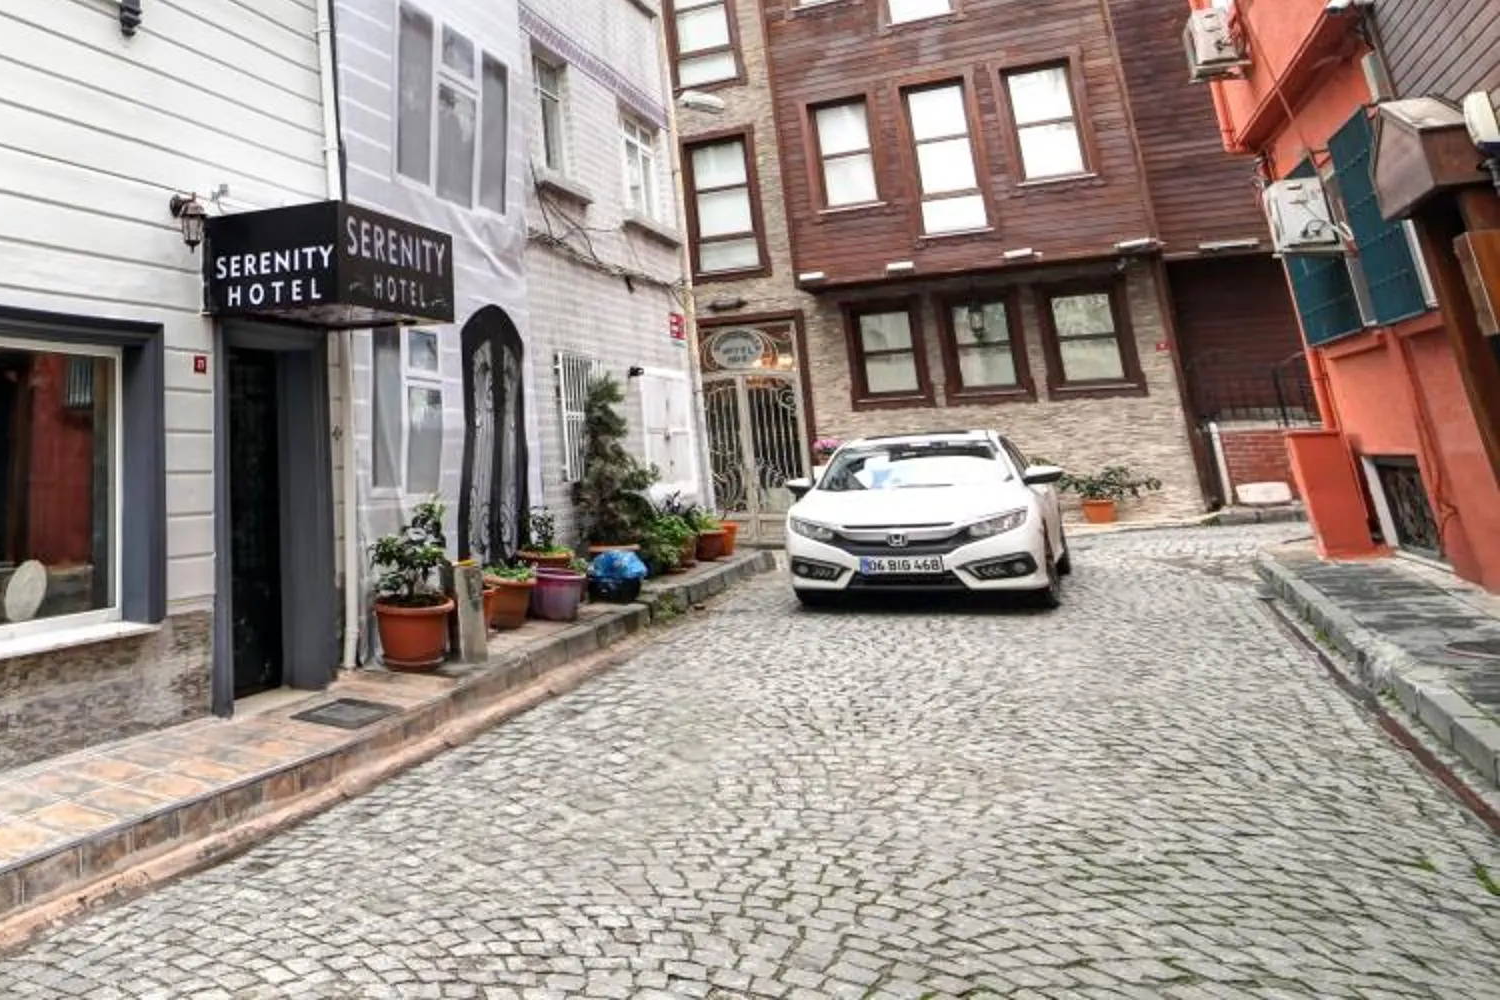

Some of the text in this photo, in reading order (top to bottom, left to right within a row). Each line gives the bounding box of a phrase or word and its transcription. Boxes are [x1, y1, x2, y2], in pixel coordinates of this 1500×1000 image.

[216, 244, 334, 280] SERENITY
[346, 215, 446, 278] SERENITY
[227, 278, 322, 307] HOTEL
[373, 273, 426, 308] HOTEL
